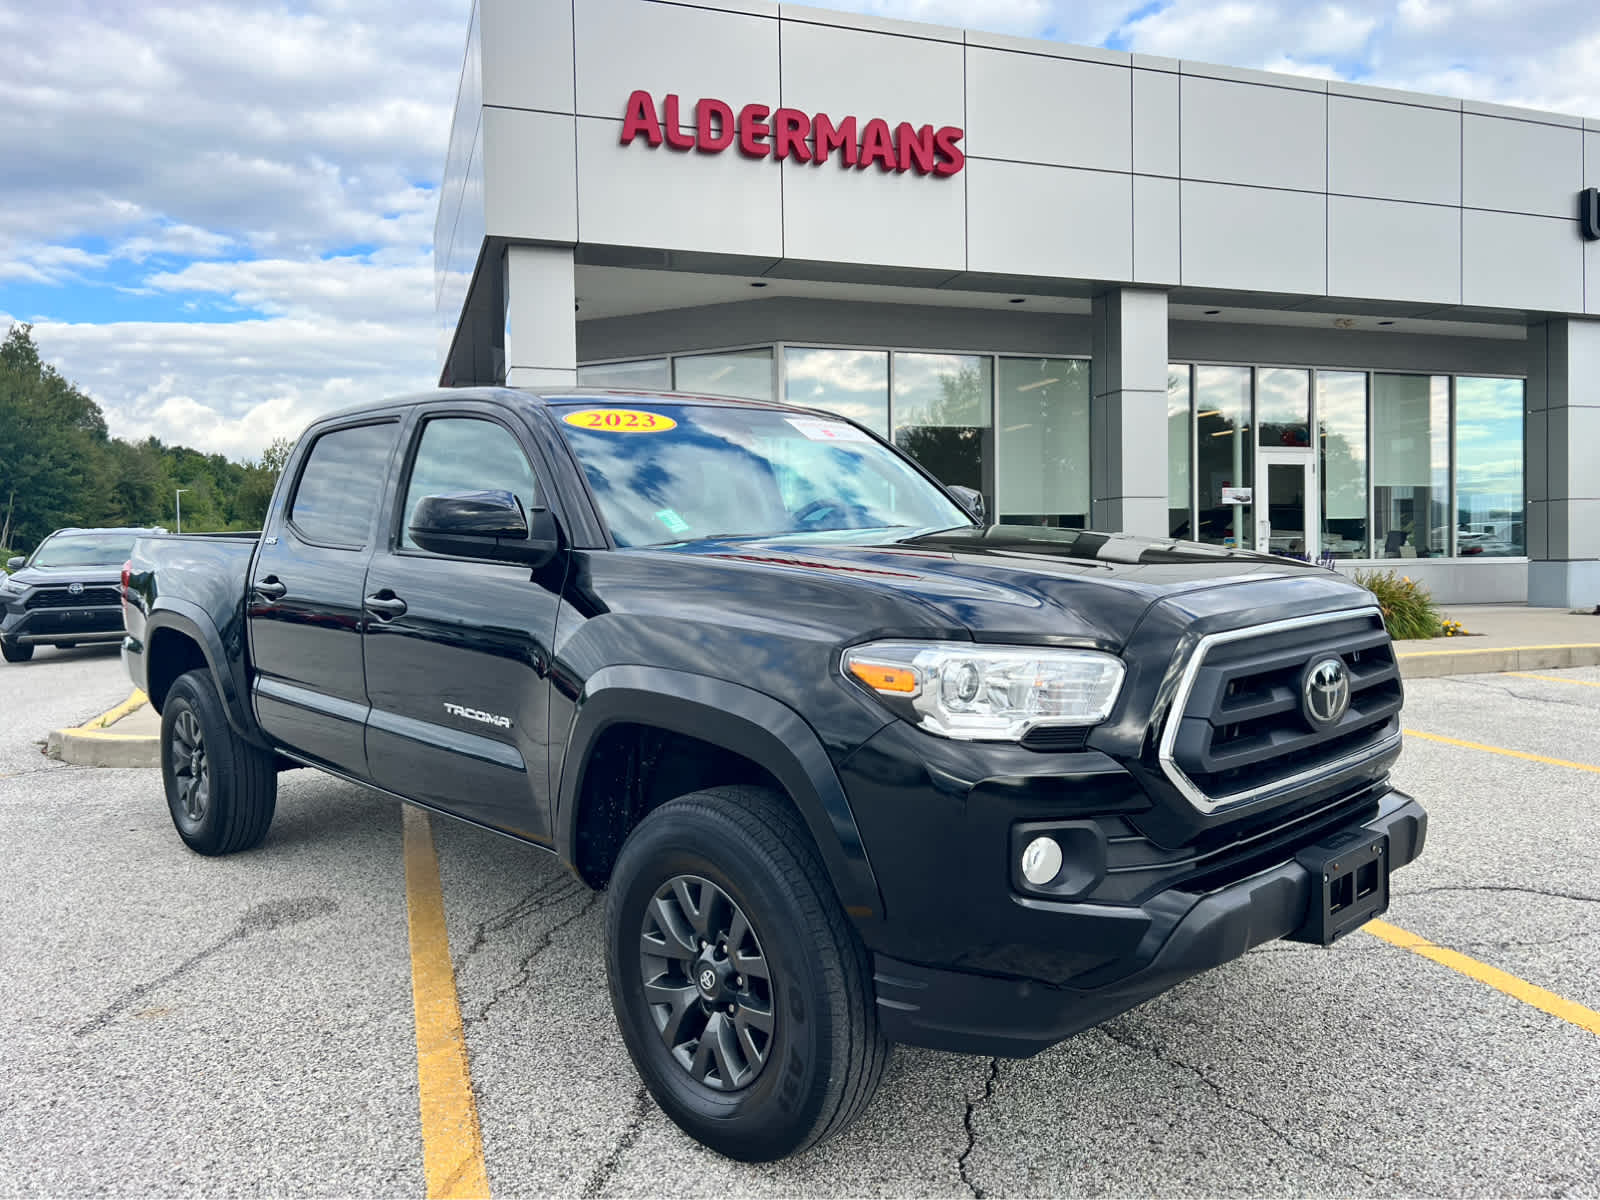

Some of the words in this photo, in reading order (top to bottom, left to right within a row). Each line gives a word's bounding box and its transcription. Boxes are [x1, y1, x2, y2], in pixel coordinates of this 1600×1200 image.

[620, 90, 965, 178] ALDERMANS
[587, 413, 657, 428] 2023
[443, 702, 510, 729] TACOMA
